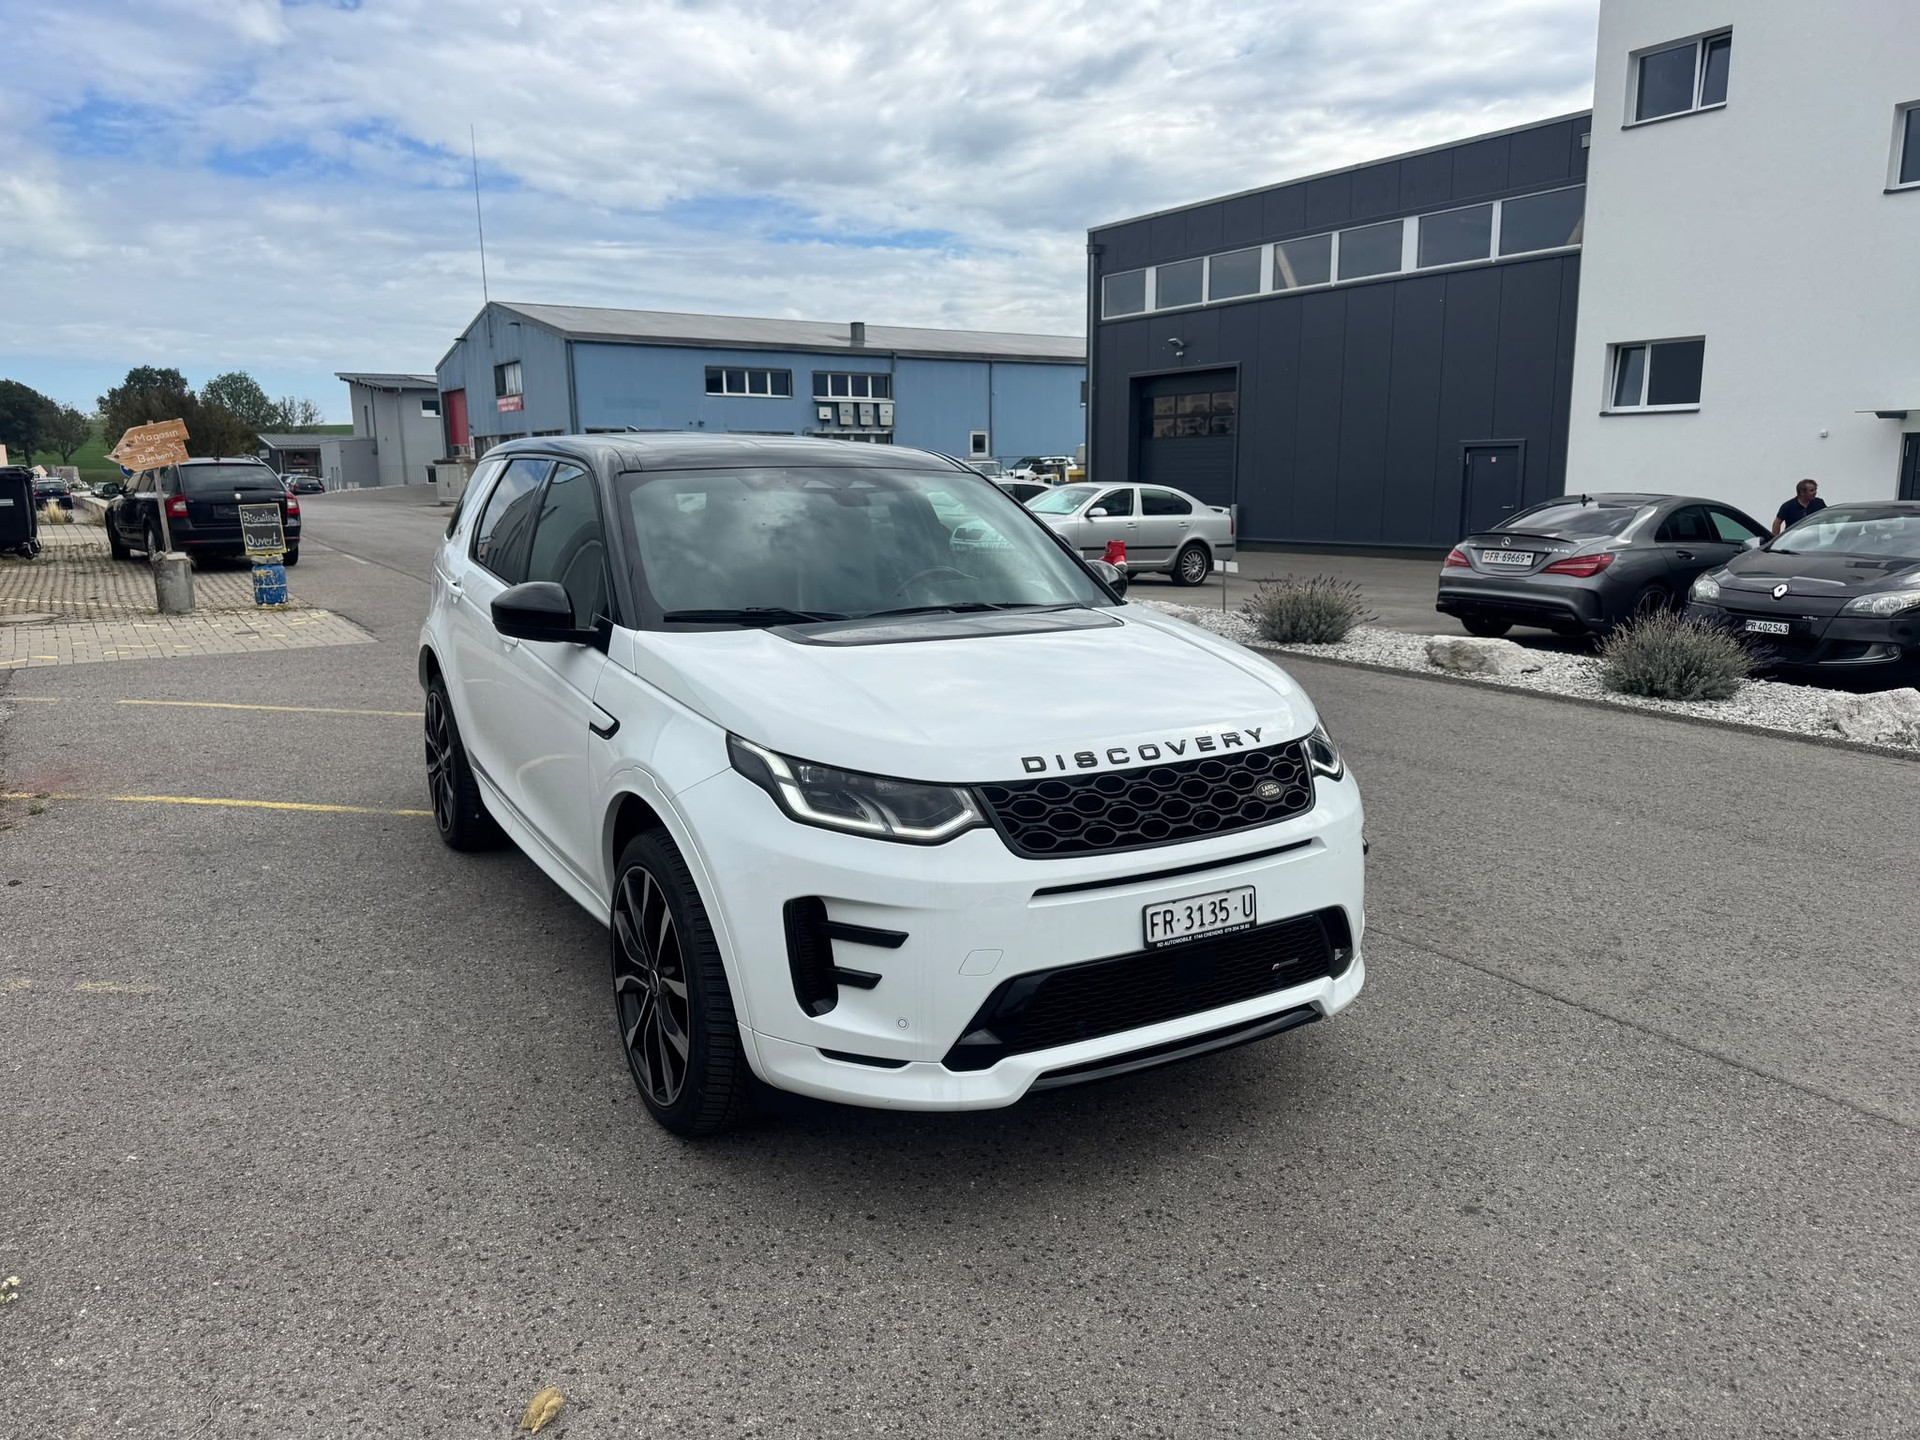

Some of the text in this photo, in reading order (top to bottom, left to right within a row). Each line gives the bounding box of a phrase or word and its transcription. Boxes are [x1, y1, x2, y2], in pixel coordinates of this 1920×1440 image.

[134, 430, 178, 444] Magasin
[137, 452, 174, 464] Bonbons
[246, 532, 280, 546] Ouvert
[1021, 727, 1262, 773] DISCOVERY
